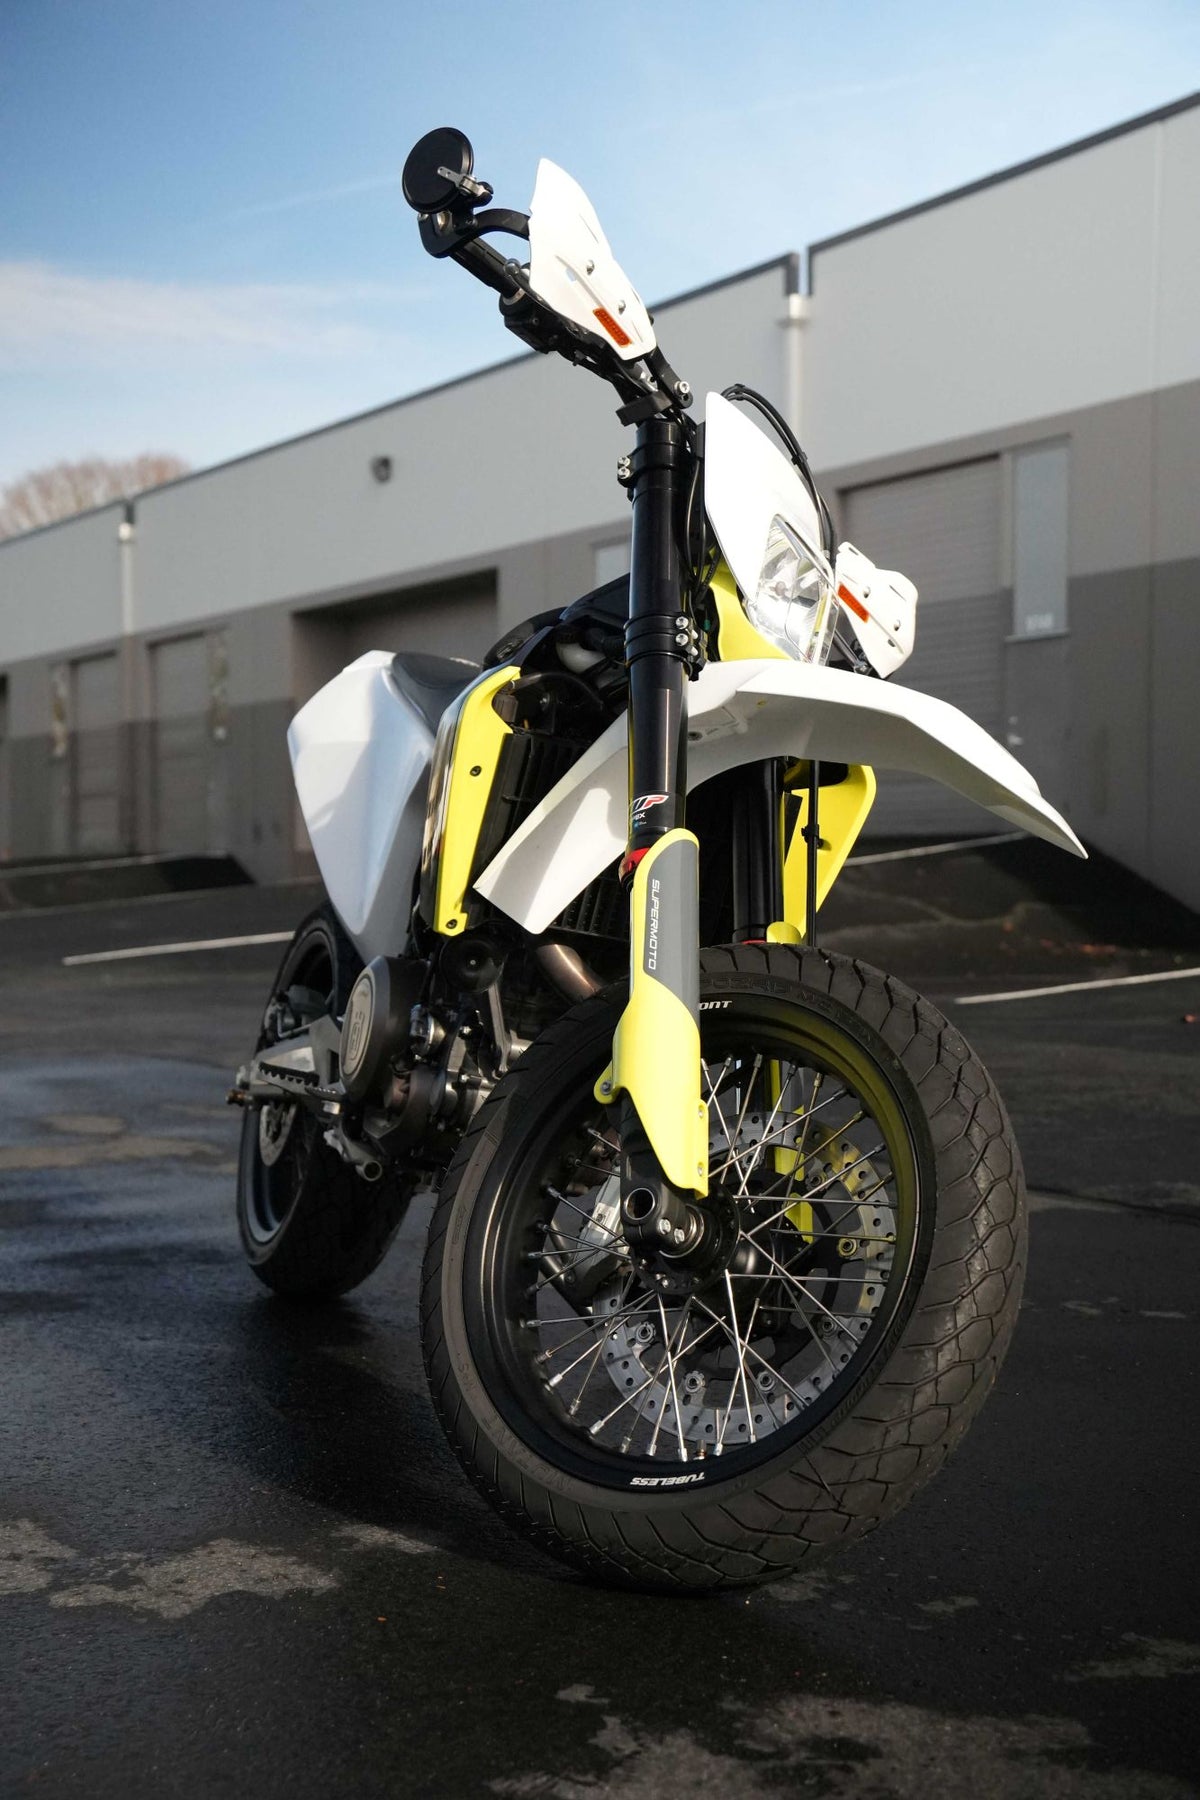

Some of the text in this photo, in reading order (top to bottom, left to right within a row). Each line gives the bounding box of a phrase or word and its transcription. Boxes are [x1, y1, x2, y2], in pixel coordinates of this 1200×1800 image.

[648, 878, 661, 971] SUPERMOTO
[699, 1000, 733, 1010] ONT
[629, 1472, 705, 1486] TUBELESS
